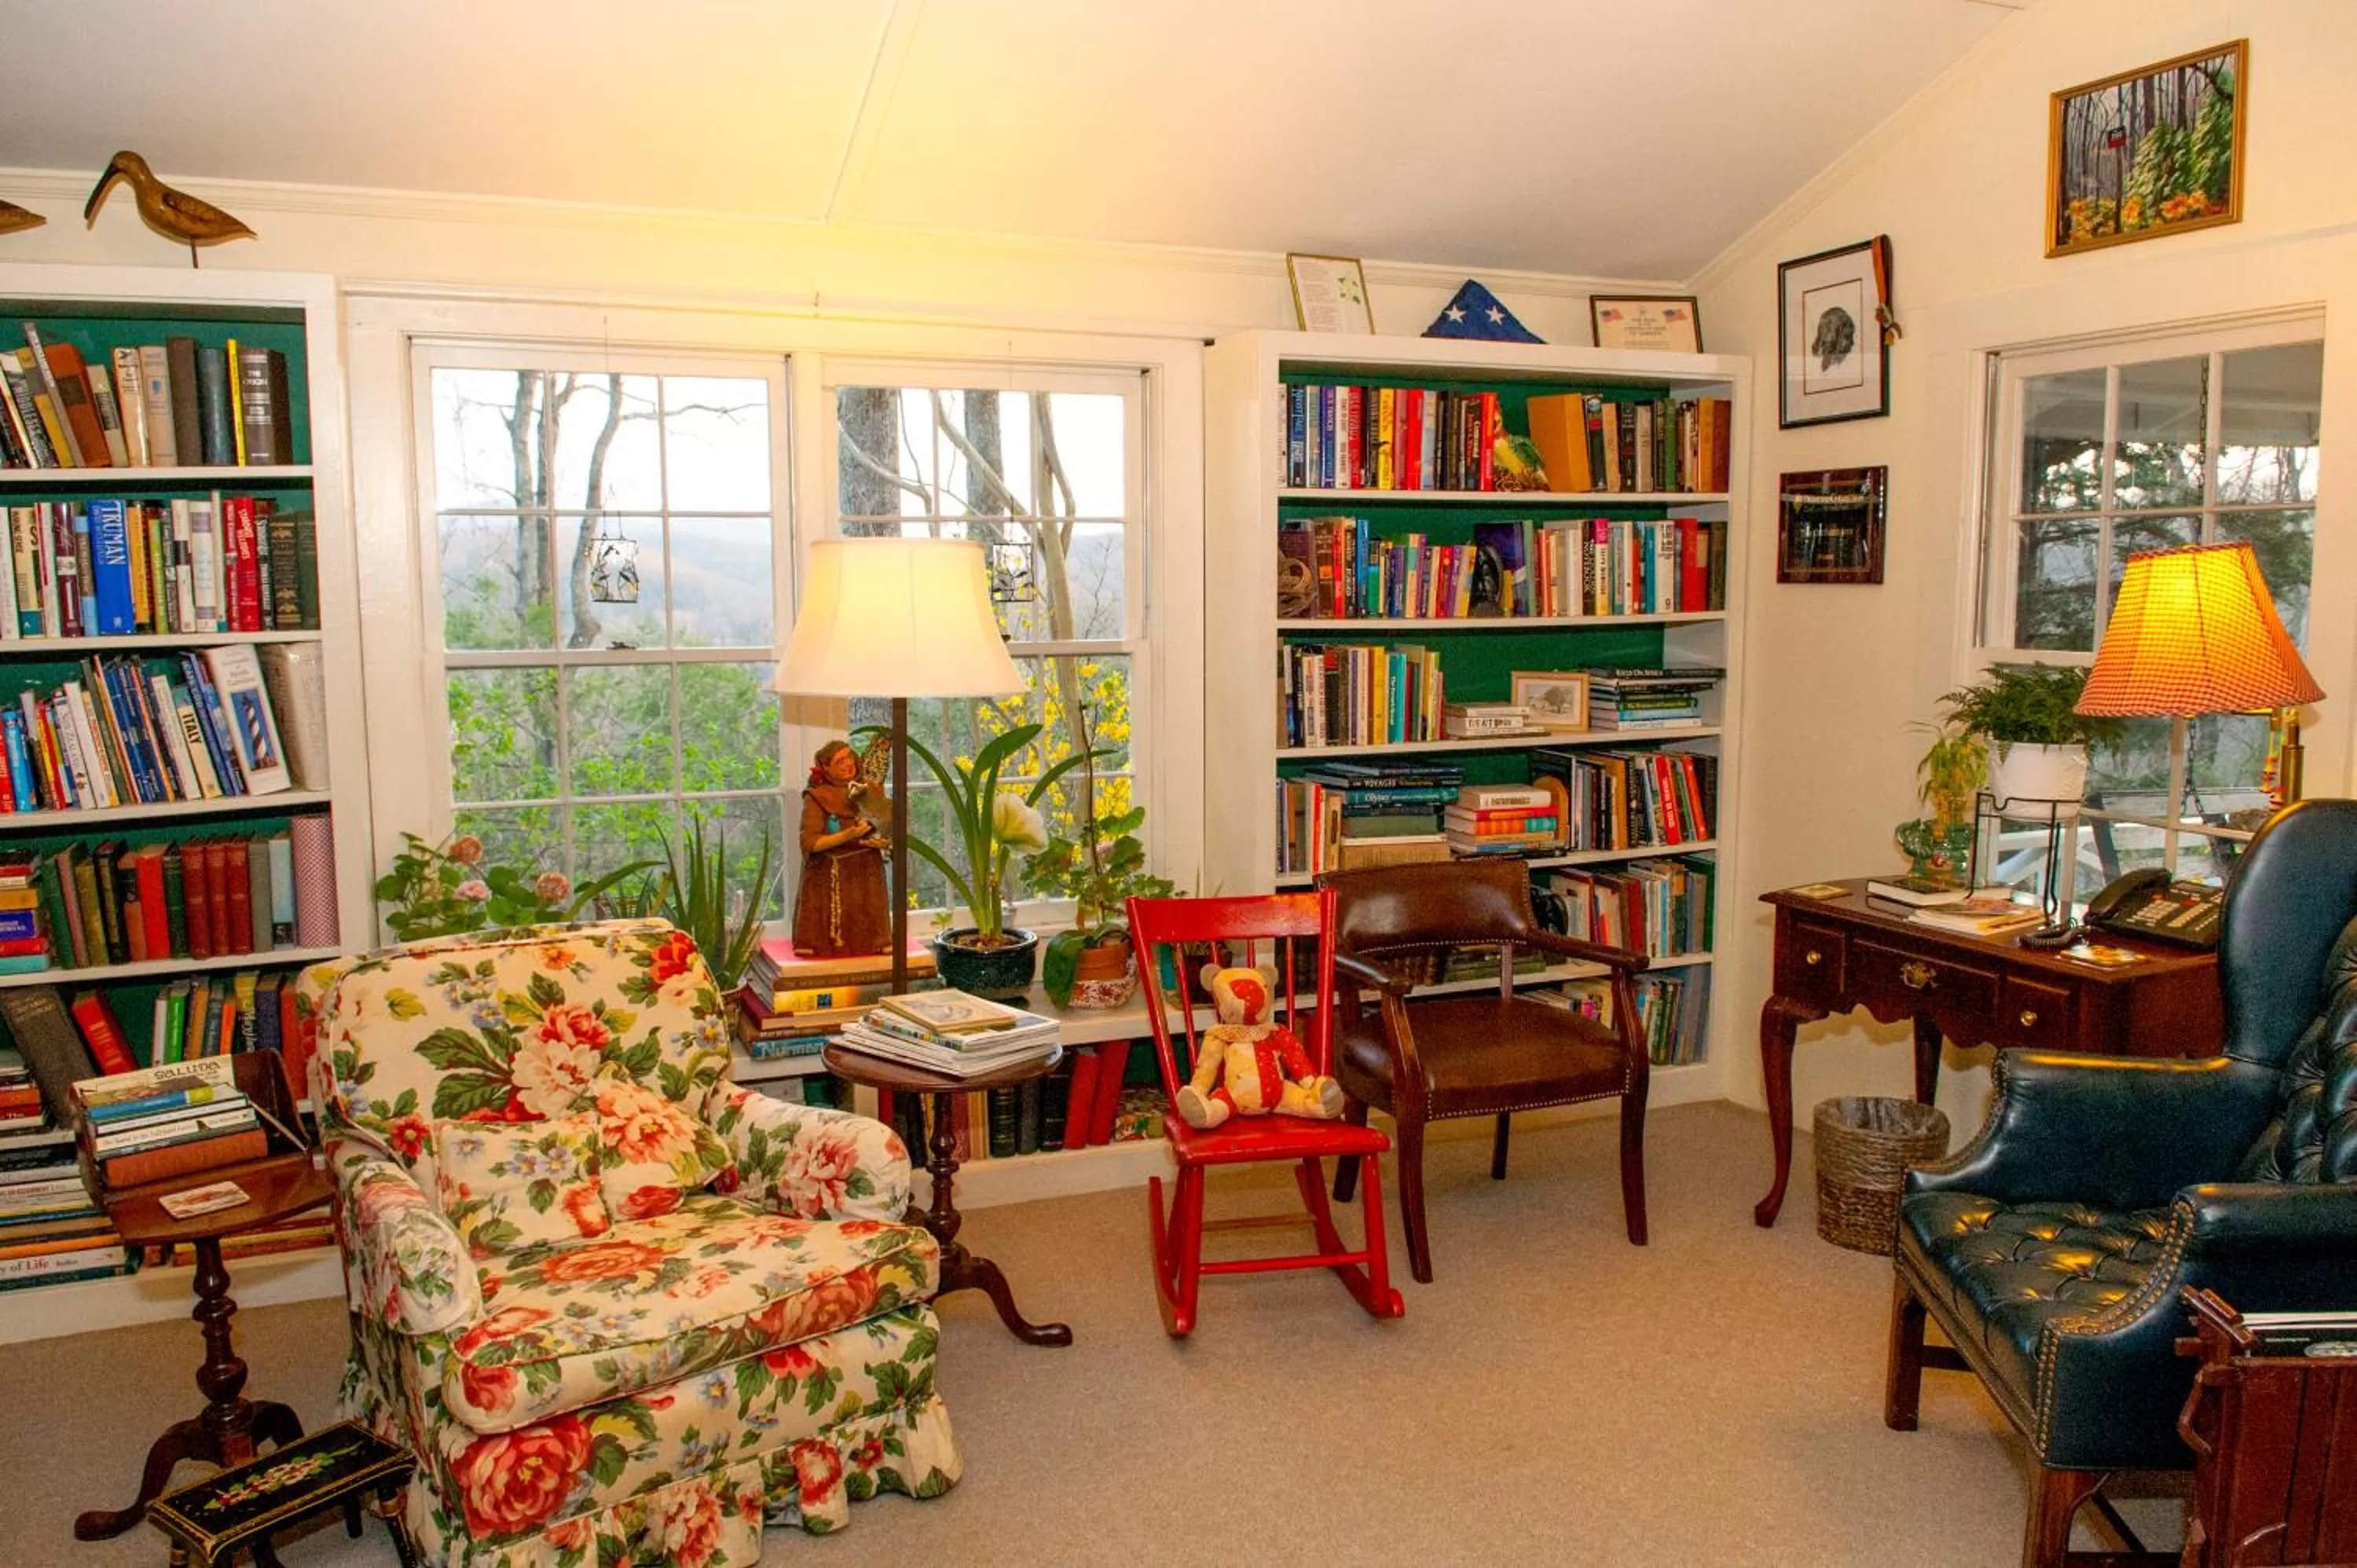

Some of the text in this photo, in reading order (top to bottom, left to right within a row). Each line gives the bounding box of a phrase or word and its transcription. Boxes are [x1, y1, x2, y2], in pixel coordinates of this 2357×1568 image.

[101, 501, 126, 565] TRUMAN
[181, 713, 202, 744] ITALY
[1364, 779, 1396, 788] VOYAGES
[26, 1258, 49, 1270] Life
